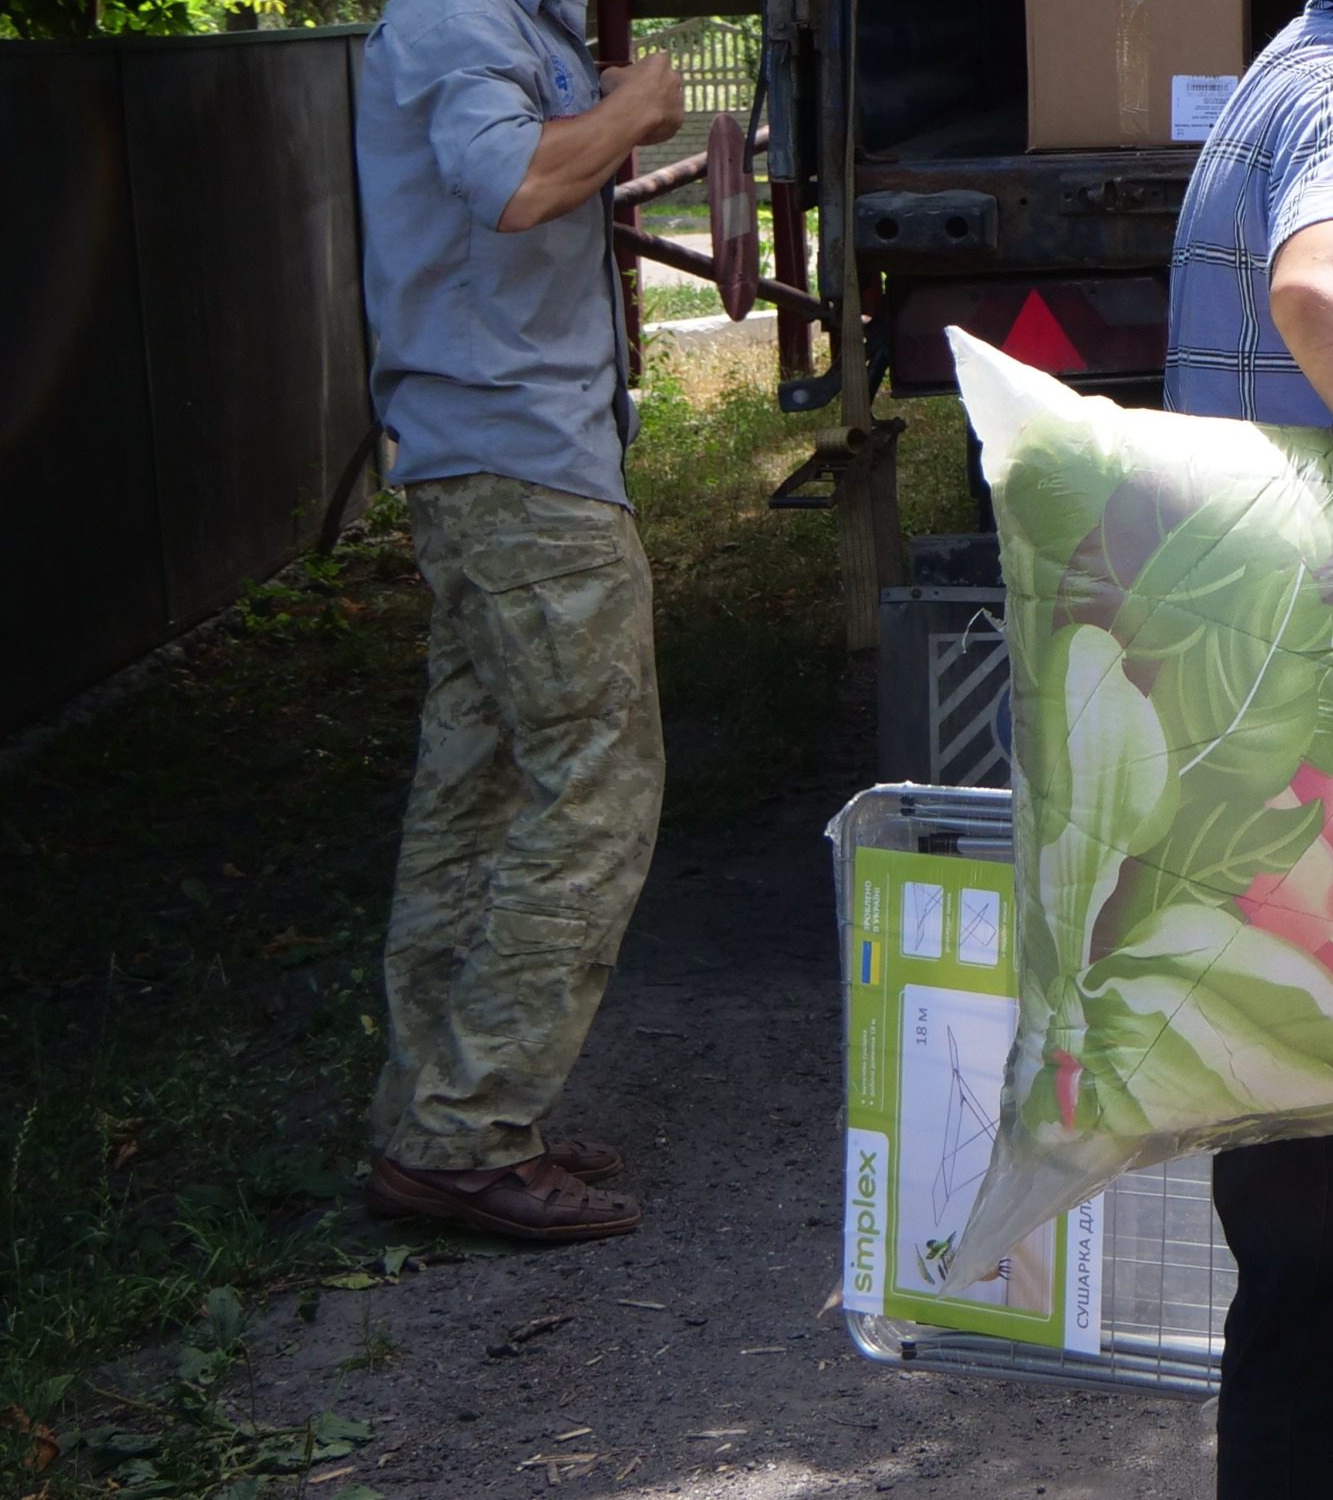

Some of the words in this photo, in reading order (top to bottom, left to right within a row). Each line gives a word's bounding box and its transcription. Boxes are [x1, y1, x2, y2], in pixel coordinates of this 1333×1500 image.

[915, 1026, 928, 1046] 18
[851, 1150, 881, 1292] simplex
[1076, 1238, 1091, 1329] СУШАРКА
